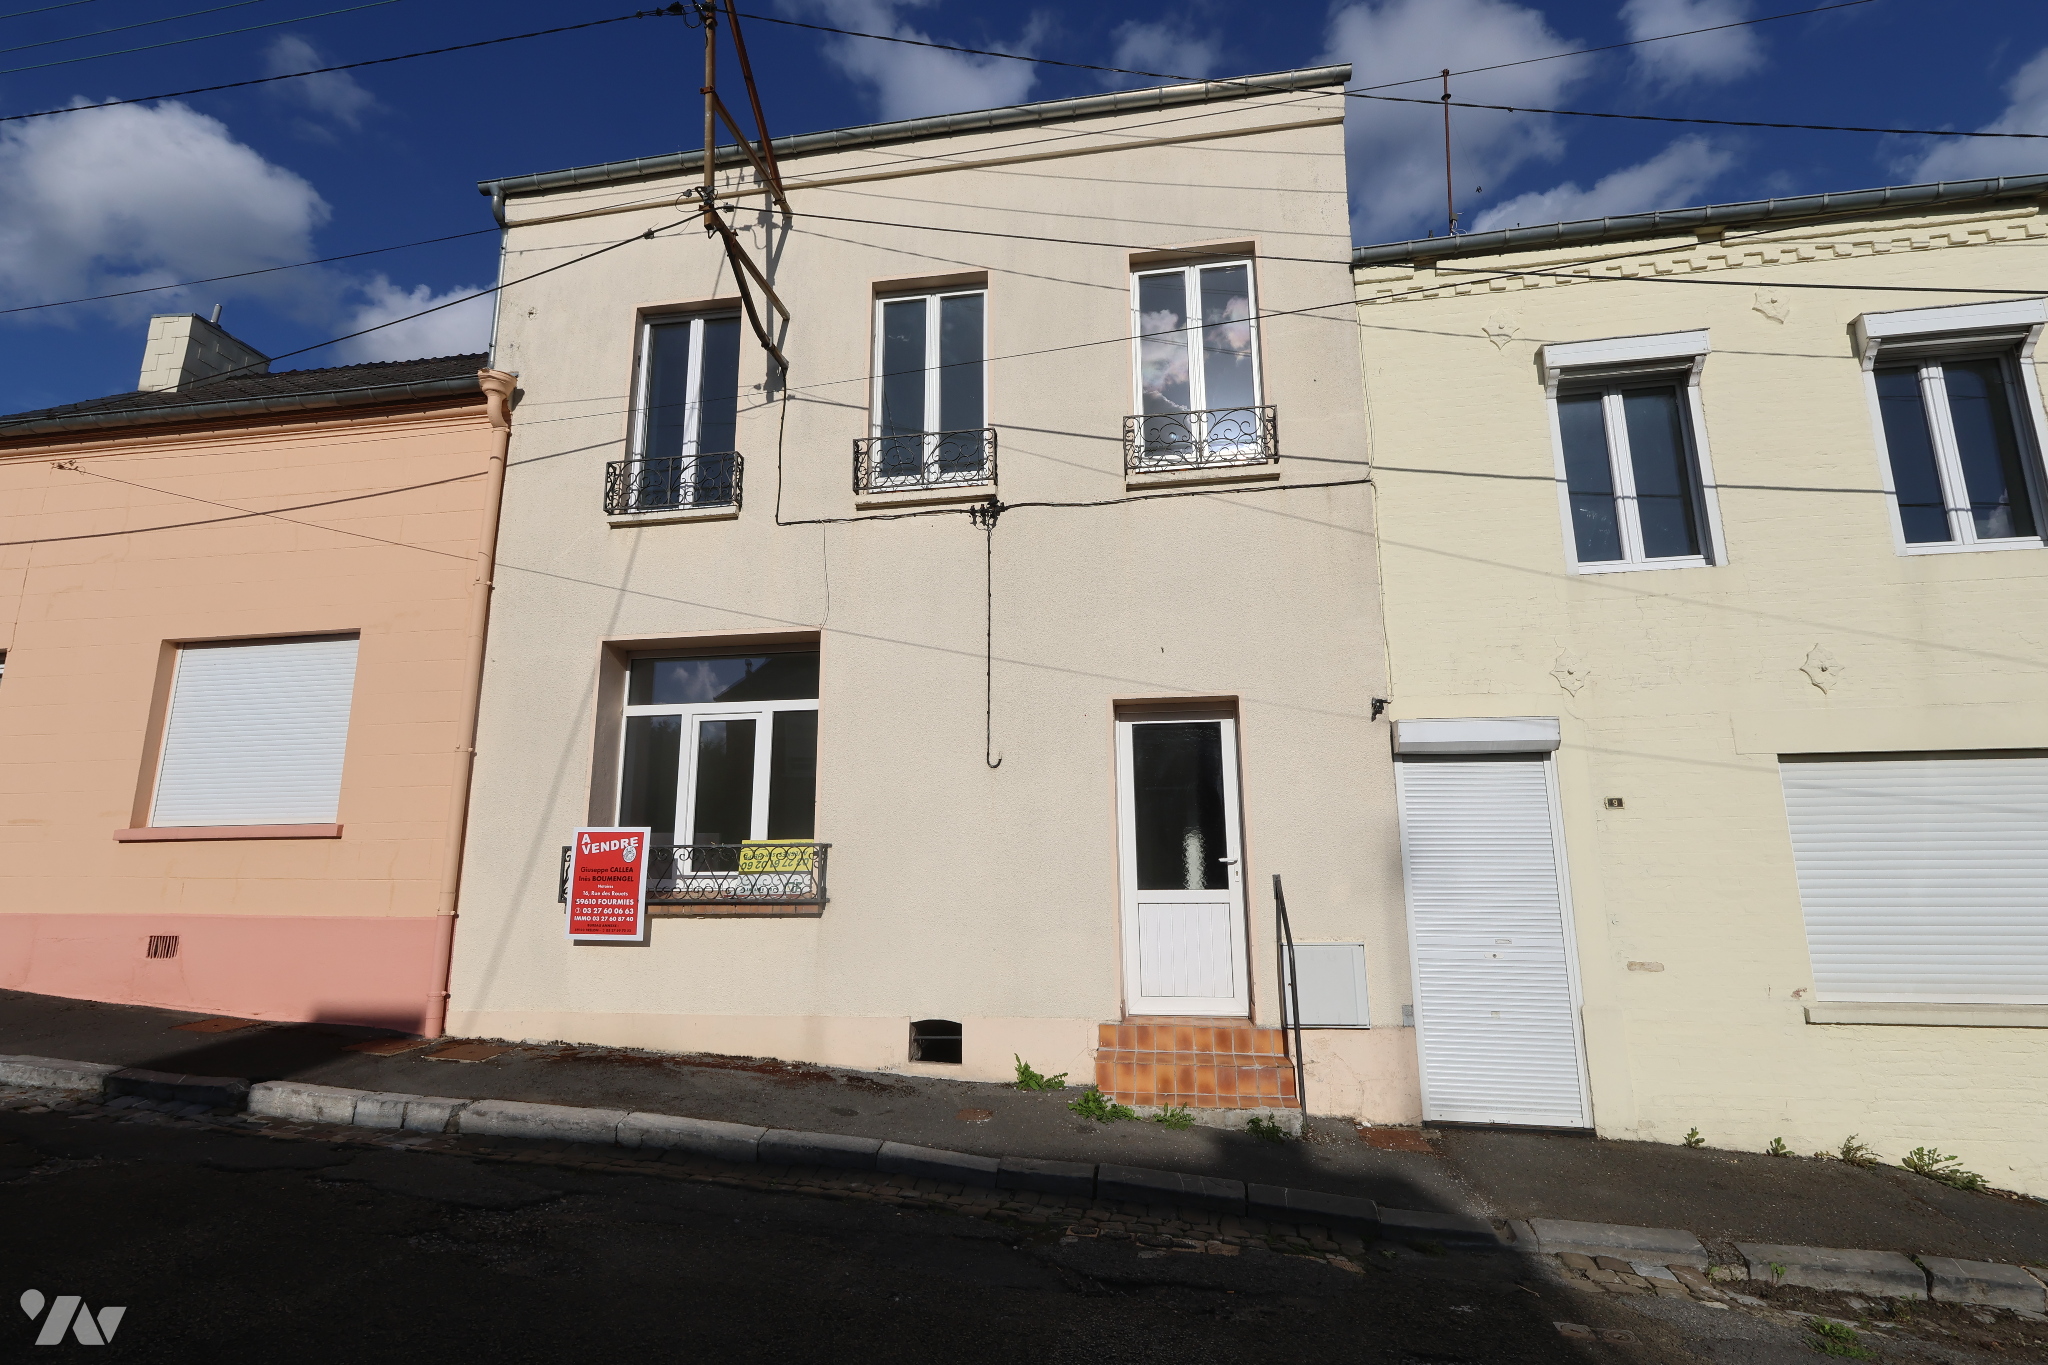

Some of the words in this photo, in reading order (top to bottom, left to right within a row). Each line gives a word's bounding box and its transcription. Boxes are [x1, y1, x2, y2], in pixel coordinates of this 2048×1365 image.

[1612, 799, 1618, 807] 9
[581, 833, 591, 844] A
[581, 836, 639, 855] VENDRE
[741, 861, 753, 870] 60
[781, 859, 794, 867] 27
[580, 866, 609, 874] Giuseppe
